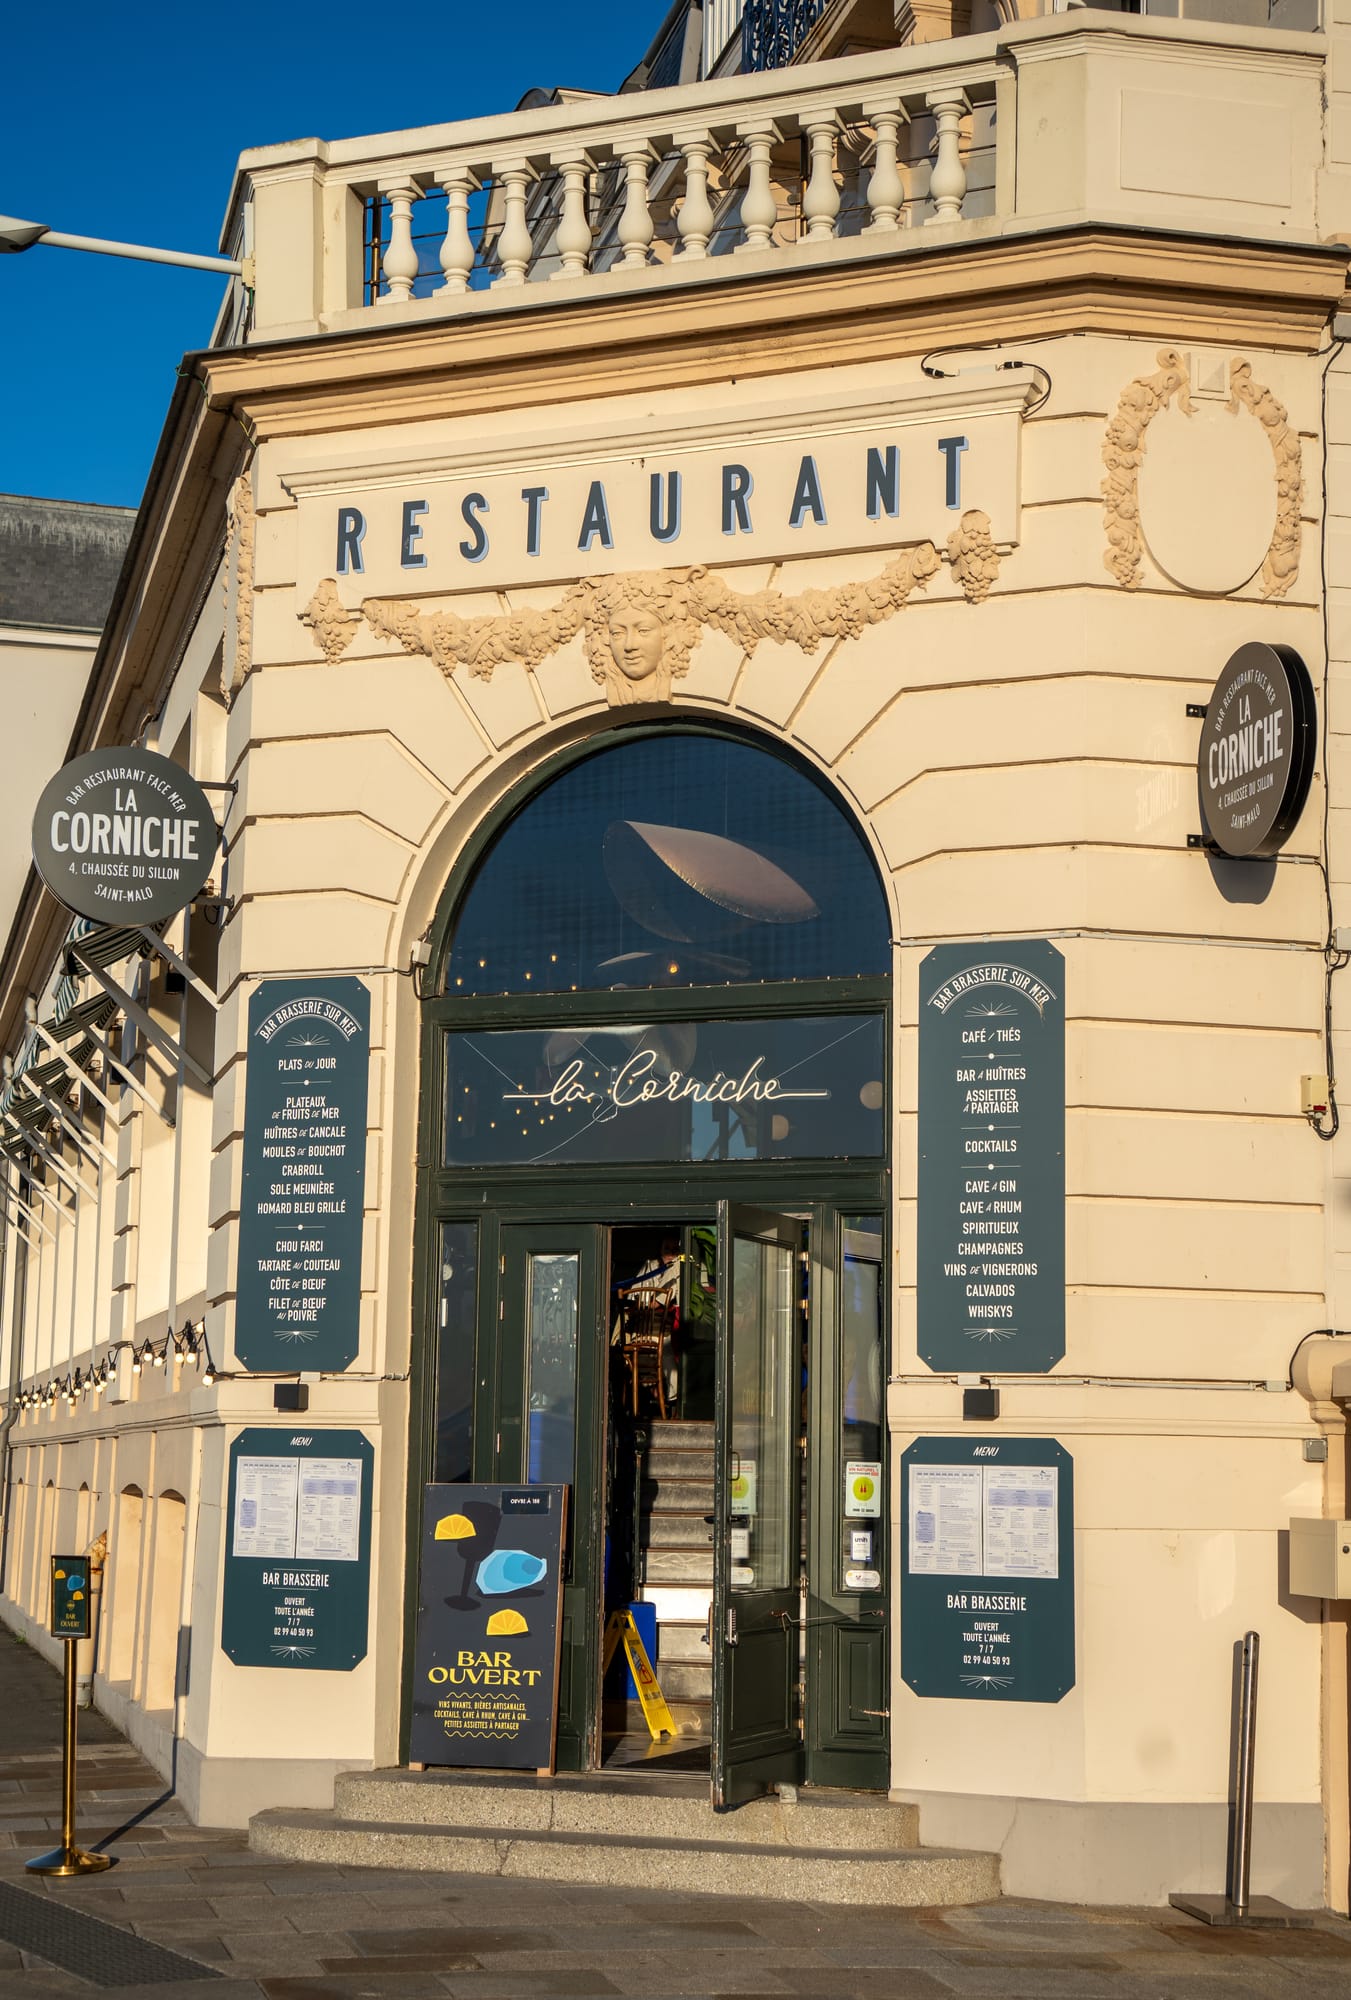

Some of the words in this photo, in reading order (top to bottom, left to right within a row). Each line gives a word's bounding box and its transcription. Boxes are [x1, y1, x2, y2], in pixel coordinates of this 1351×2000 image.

[336, 435, 968, 575] RESTAURANT
[1215, 708, 1226, 732] BAR
[1223, 669, 1254, 709] RESTAURANT
[1255, 670, 1267, 690] FACE
[1265, 682, 1276, 705] MER
[1240, 694, 1251, 725] LA
[1208, 708, 1283, 790] CORNICHE
[65, 785, 86, 805] BAR
[83, 768, 146, 790] RESTAURANT
[146, 774, 171, 795] FACE
[167, 793, 187, 813] MER
[1224, 783, 1248, 807] CHAUSSÉE
[1249, 781, 1256, 796] DU
[1257, 773, 1273, 792] SILLON
[115, 788, 138, 812] LA
[1231, 803, 1260, 828] SAINT-MALO
[51, 811, 199, 860] CORNICHE
[81, 862, 129, 877] CHAUSSÉE
[132, 866, 145, 878] DU
[148, 867, 180, 880] SILLON
[94, 884, 153, 902] SAINT-MALO
[933, 988, 954, 1009] BAR
[952, 967, 1009, 992] BRASSERIE
[1010, 971, 1031, 990] SUR
[1029, 983, 1050, 1005] MER
[260, 1019, 278, 1039] BAR
[276, 1001, 323, 1024] BRASSERIE
[324, 1005, 341, 1022] SUR
[340, 1016, 357, 1036] MER
[962, 1028, 986, 1043] CAFÉ
[996, 1027, 1021, 1042] THÉS
[278, 1059, 302, 1070] PLATS
[315, 1058, 336, 1069] JOUR
[612, 1049, 829, 1106] Corniche
[956, 1070, 976, 1081] BAR
[986, 1065, 1026, 1080] HUÎTRES
[966, 1088, 1016, 1102] ASSIETTES
[286, 1096, 326, 1108] PLATEAUX
[971, 1101, 1019, 1114] PARTAGER
[282, 1108, 310, 1120] FRUITS
[322, 1107, 340, 1119] MER
[264, 1125, 297, 1139] HUÎTRES
[309, 1126, 346, 1138] CANCALE
[263, 1146, 295, 1158] MOULES
[308, 1145, 346, 1157] BOUCHOT
[965, 1140, 1017, 1153] COCKTAILS
[282, 1164, 324, 1176] CRABROLL
[270, 1184, 291, 1195] SOLE
[293, 1181, 334, 1194] MEUNIÈRE
[965, 1181, 990, 1193] CAVE
[1000, 1180, 1016, 1193] GIN
[257, 1202, 291, 1214] HOMARD
[294, 1202, 314, 1214] BLEU
[317, 1199, 346, 1213] GRILLÉ
[960, 1201, 984, 1214] CAVE
[994, 1201, 1022, 1213] RHUM
[962, 1222, 1019, 1234] SPIRITUEUX
[276, 1240, 298, 1252] CHOU
[300, 1240, 323, 1252] FARCI
[958, 1242, 1024, 1255] CHAMPAGNES
[258, 1260, 291, 1271] TARTARE
[303, 1259, 340, 1271] COUTEAU
[944, 1264, 967, 1276] VINS
[969, 1266, 980, 1274] DE
[982, 1263, 1038, 1276] VIGNERONS
[270, 1277, 290, 1290] CÔTE
[302, 1279, 326, 1290] BŒUF
[966, 1284, 1015, 1297] CALVADOS
[269, 1298, 291, 1309] FILET
[302, 1298, 326, 1309] BŒUF
[287, 1310, 317, 1321] POIVRE
[968, 1305, 1013, 1318] WHISKYS
[290, 1437, 312, 1446] MENU
[973, 1446, 999, 1457] MENU
[263, 1572, 280, 1585] BAR
[283, 1573, 329, 1587] BRASSERIE
[284, 1597, 305, 1606] OUVERT
[947, 1595, 967, 1609] BAR
[971, 1595, 1027, 1611] BRASSERIE
[274, 1607, 291, 1616] TOUTE
[292, 1607, 315, 1616] L'ANNÉE
[274, 1627, 281, 1636] 02
[282, 1627, 289, 1636] 99
[298, 1628, 305, 1636] 50
[306, 1628, 313, 1637] 93
[974, 1622, 999, 1631] OUVERT
[963, 1632, 983, 1642] TOUTE
[984, 1633, 1011, 1643] L'ANNÉE
[457, 1651, 512, 1668] BAR
[963, 1655, 971, 1664] 02
[973, 1655, 981, 1664] 99
[983, 1656, 990, 1664] 40
[993, 1656, 1000, 1665] 50
[1002, 1656, 1010, 1666] 93
[428, 1667, 542, 1686] OUVERT
[474, 1701, 492, 1709] BIÈRES
[462, 1711, 474, 1719] CAVE
[476, 1710, 480, 1719] À
[498, 1712, 510, 1720] CAVE
[512, 1711, 516, 1720] À
[444, 1720, 462, 1728] PETITES
[464, 1721, 487, 1729] ASSIETTES
[489, 1721, 493, 1729] À
[495, 1722, 519, 1730] PARTAGER
